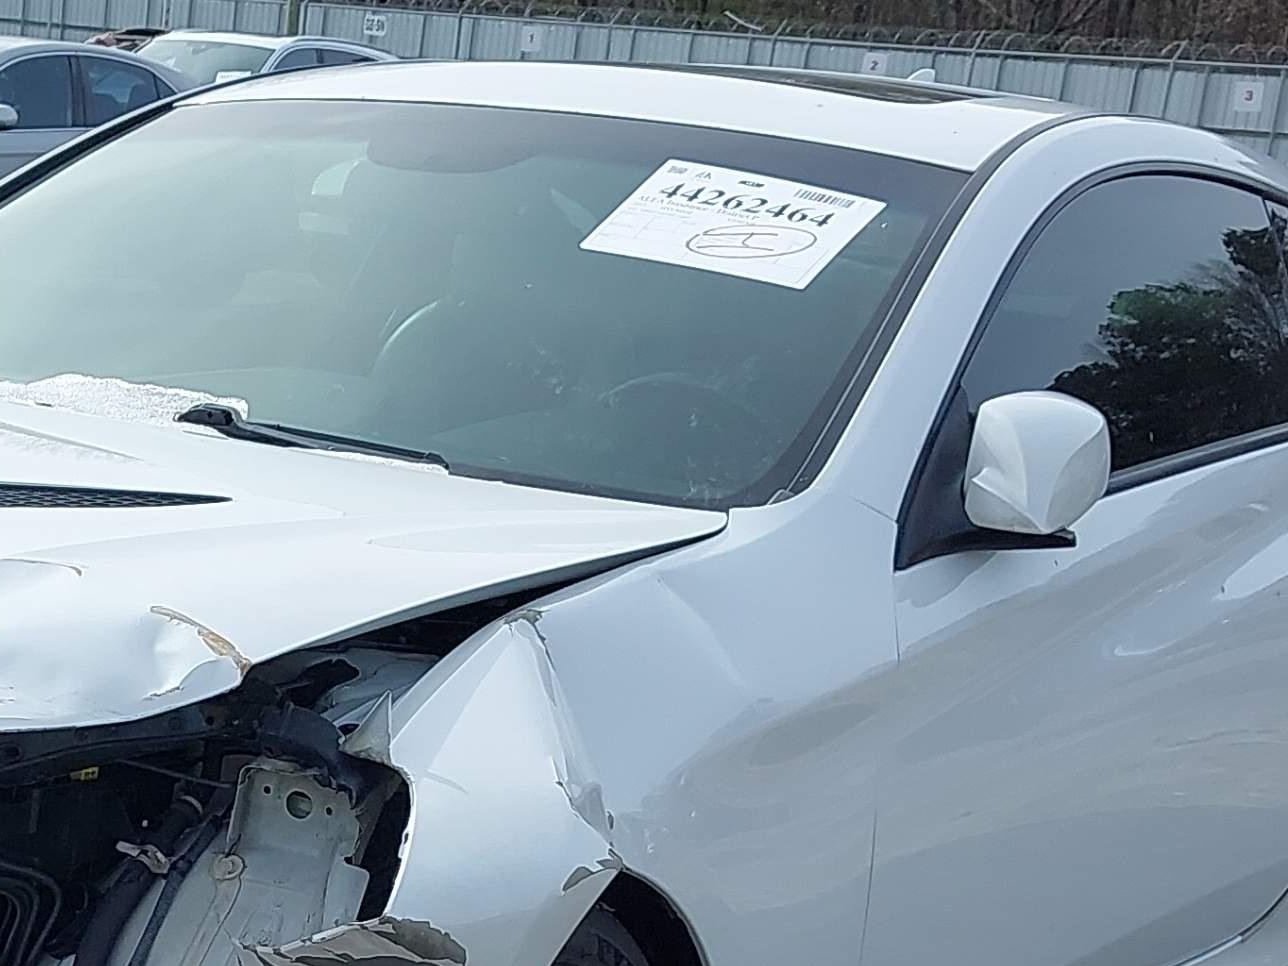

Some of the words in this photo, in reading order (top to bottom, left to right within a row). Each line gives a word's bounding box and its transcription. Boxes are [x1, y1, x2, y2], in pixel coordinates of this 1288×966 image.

[870, 60, 879, 71] 2
[1244, 90, 1254, 102] 3
[658, 182, 836, 228] 44262464
